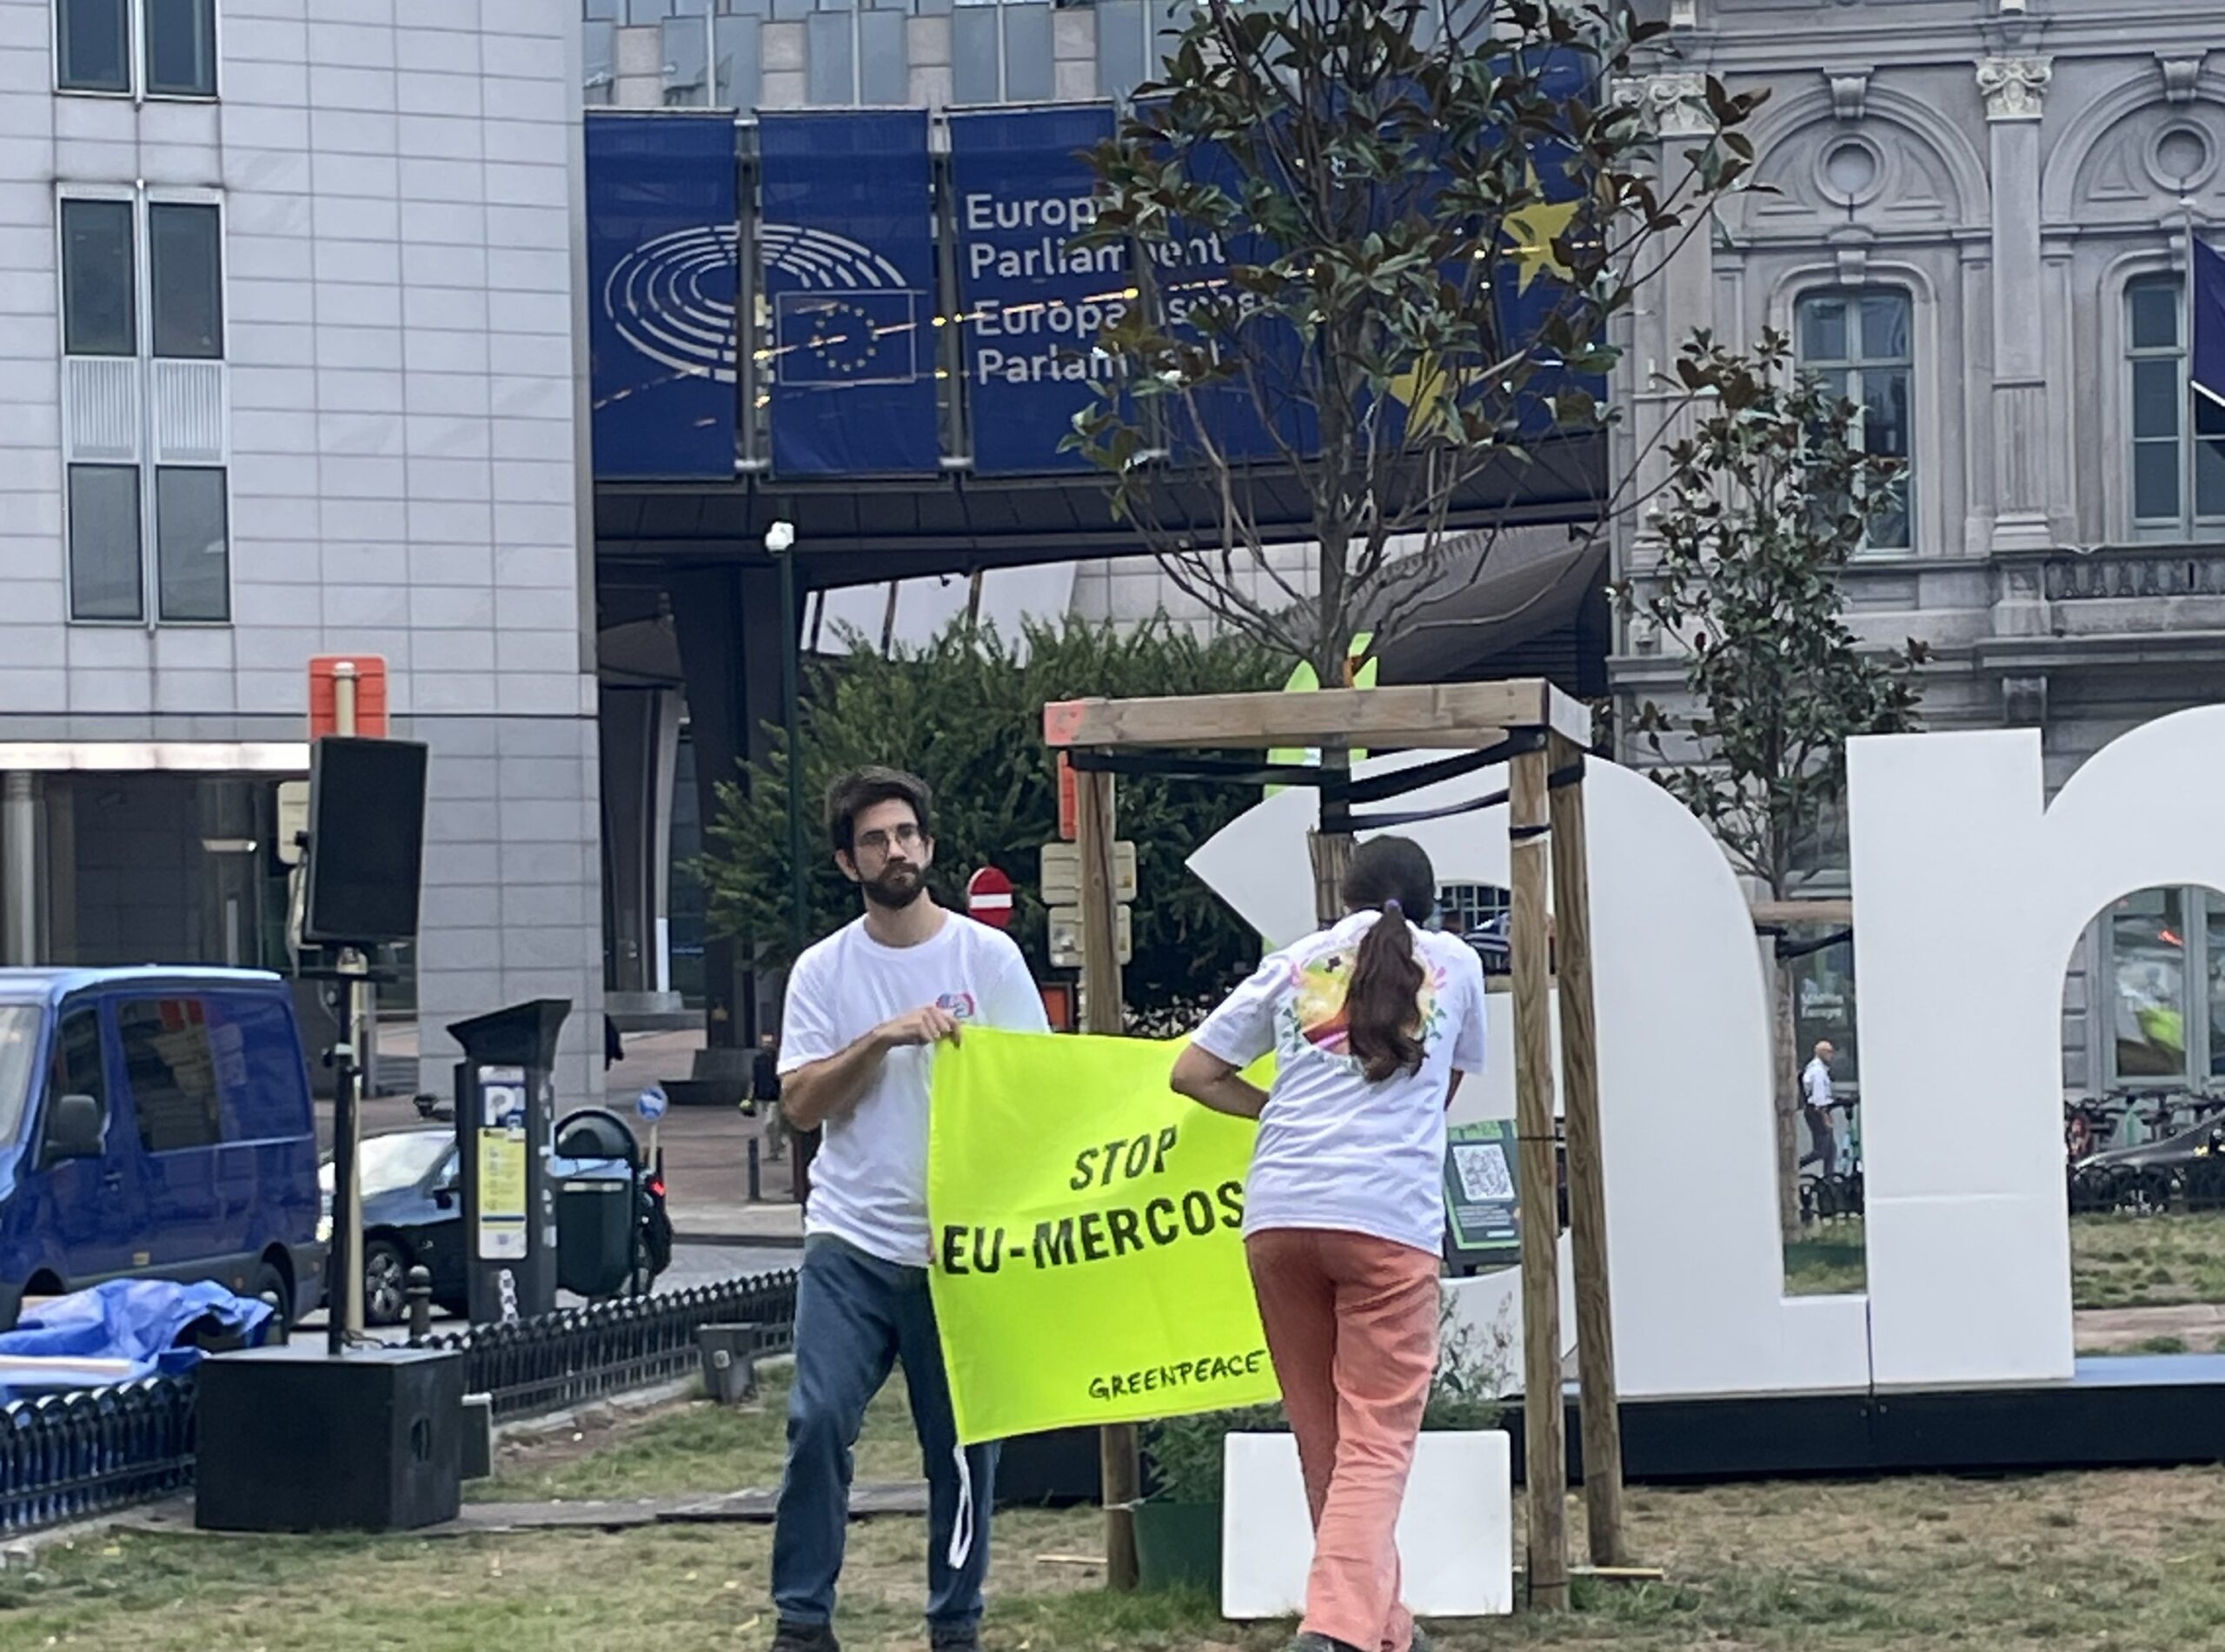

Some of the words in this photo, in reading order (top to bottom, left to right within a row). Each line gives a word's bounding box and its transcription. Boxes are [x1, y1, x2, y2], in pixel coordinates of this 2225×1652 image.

[966, 190, 1169, 233] Europ
[977, 338, 1221, 385] Parlam
[484, 1086, 515, 1126] P
[1069, 1124, 1178, 1191] STOP
[1087, 1350, 1266, 1402] GREENPEACE
